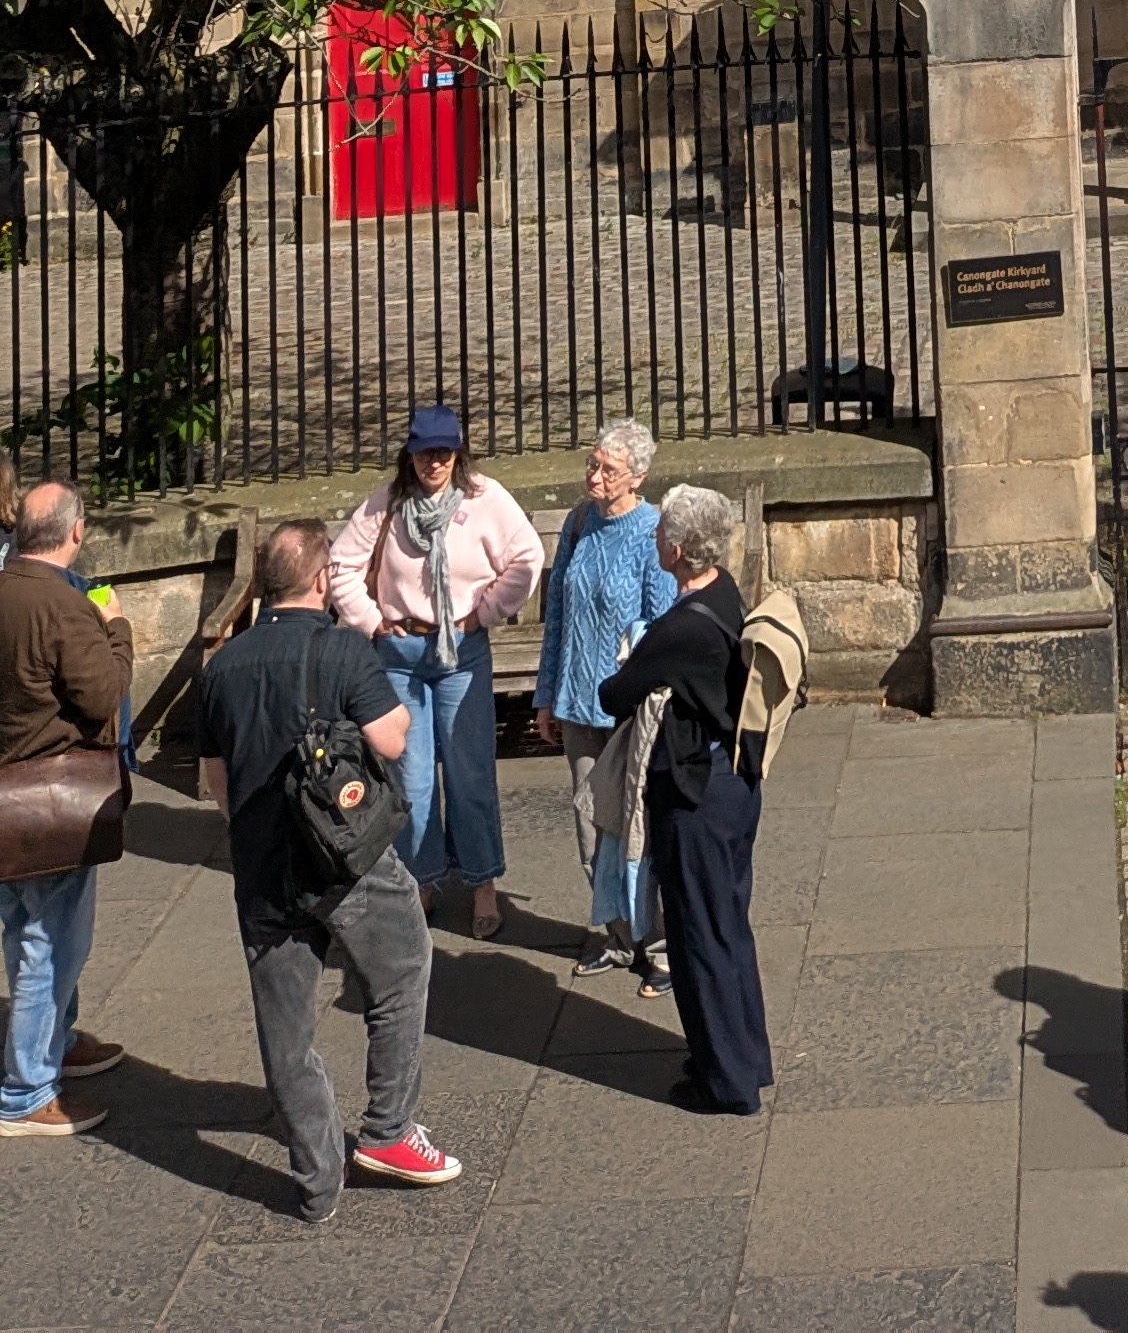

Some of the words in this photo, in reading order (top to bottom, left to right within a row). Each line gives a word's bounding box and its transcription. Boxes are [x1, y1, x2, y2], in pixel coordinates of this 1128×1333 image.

[956, 268, 1006, 282] Canongate
[1007, 263, 1046, 278] Kirkyard
[957, 282, 985, 295] Cladh
[995, 276, 1051, 291] Chanongate
